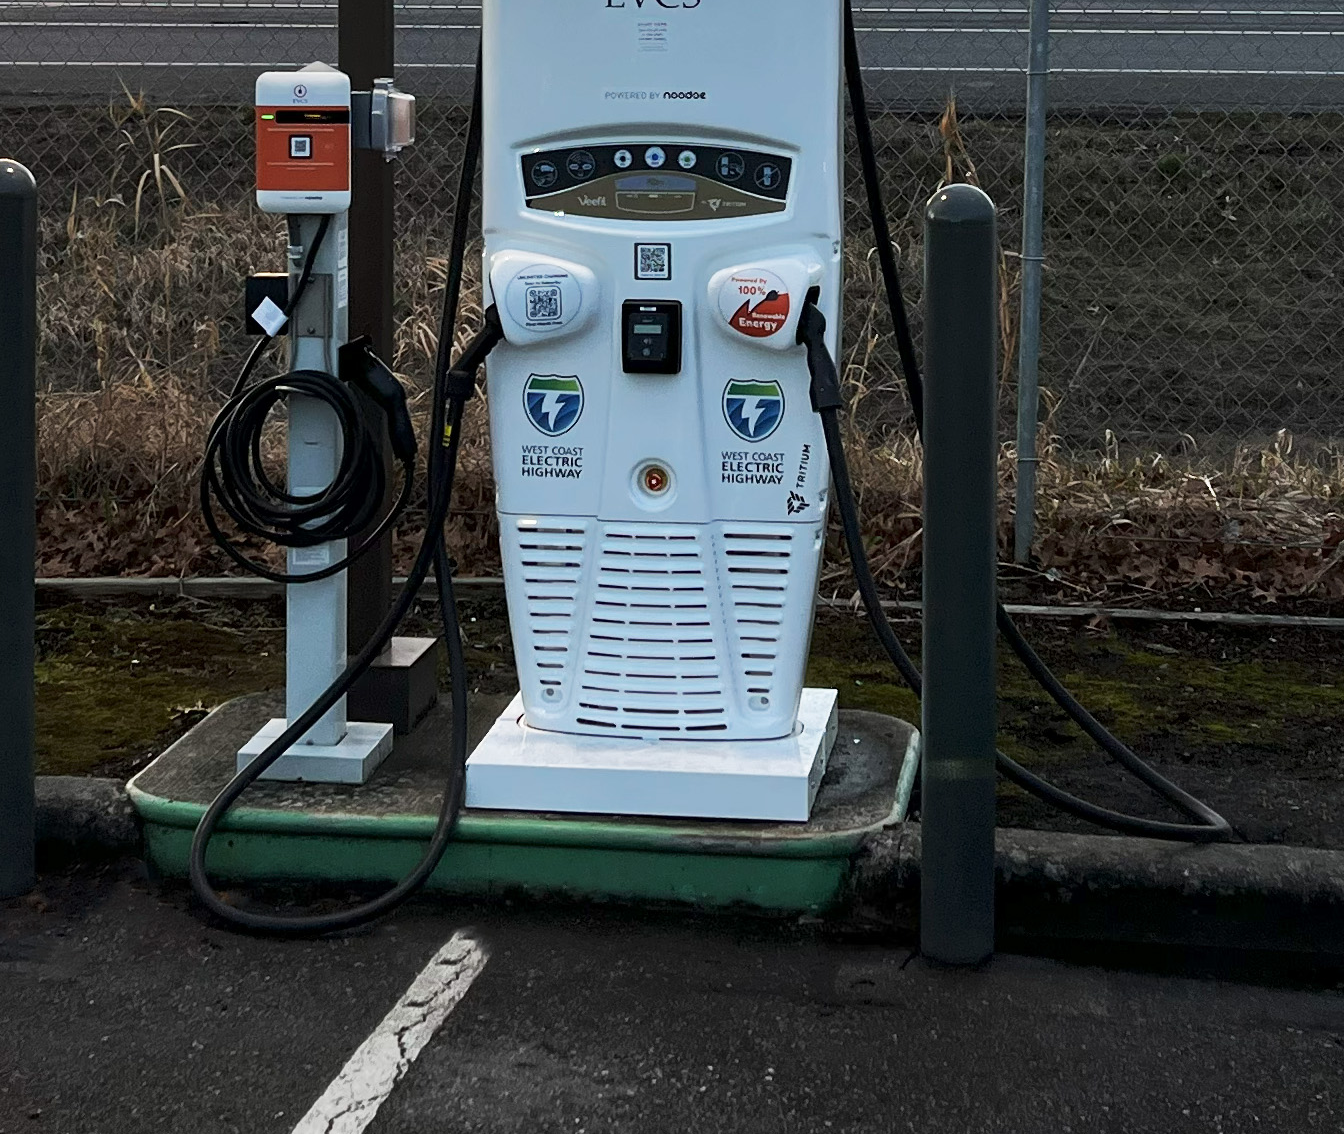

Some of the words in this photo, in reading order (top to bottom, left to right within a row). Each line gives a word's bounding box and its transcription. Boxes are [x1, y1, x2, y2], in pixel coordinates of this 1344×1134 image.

[605, 91, 647, 100] POWERED
[649, 91, 660, 100] BY
[738, 317, 778, 332] Energy
[522, 445, 549, 454] WEST
[551, 446, 584, 456] COAST
[721, 451, 749, 461] WEST
[751, 452, 785, 462] COAST
[522, 455, 583, 468] ELECTRIC
[722, 461, 784, 474] ELECTRIC
[795, 443, 812, 489] TRITIUM
[522, 467, 583, 479] HIGHWAY
[722, 473, 784, 485] HIGHWAY
